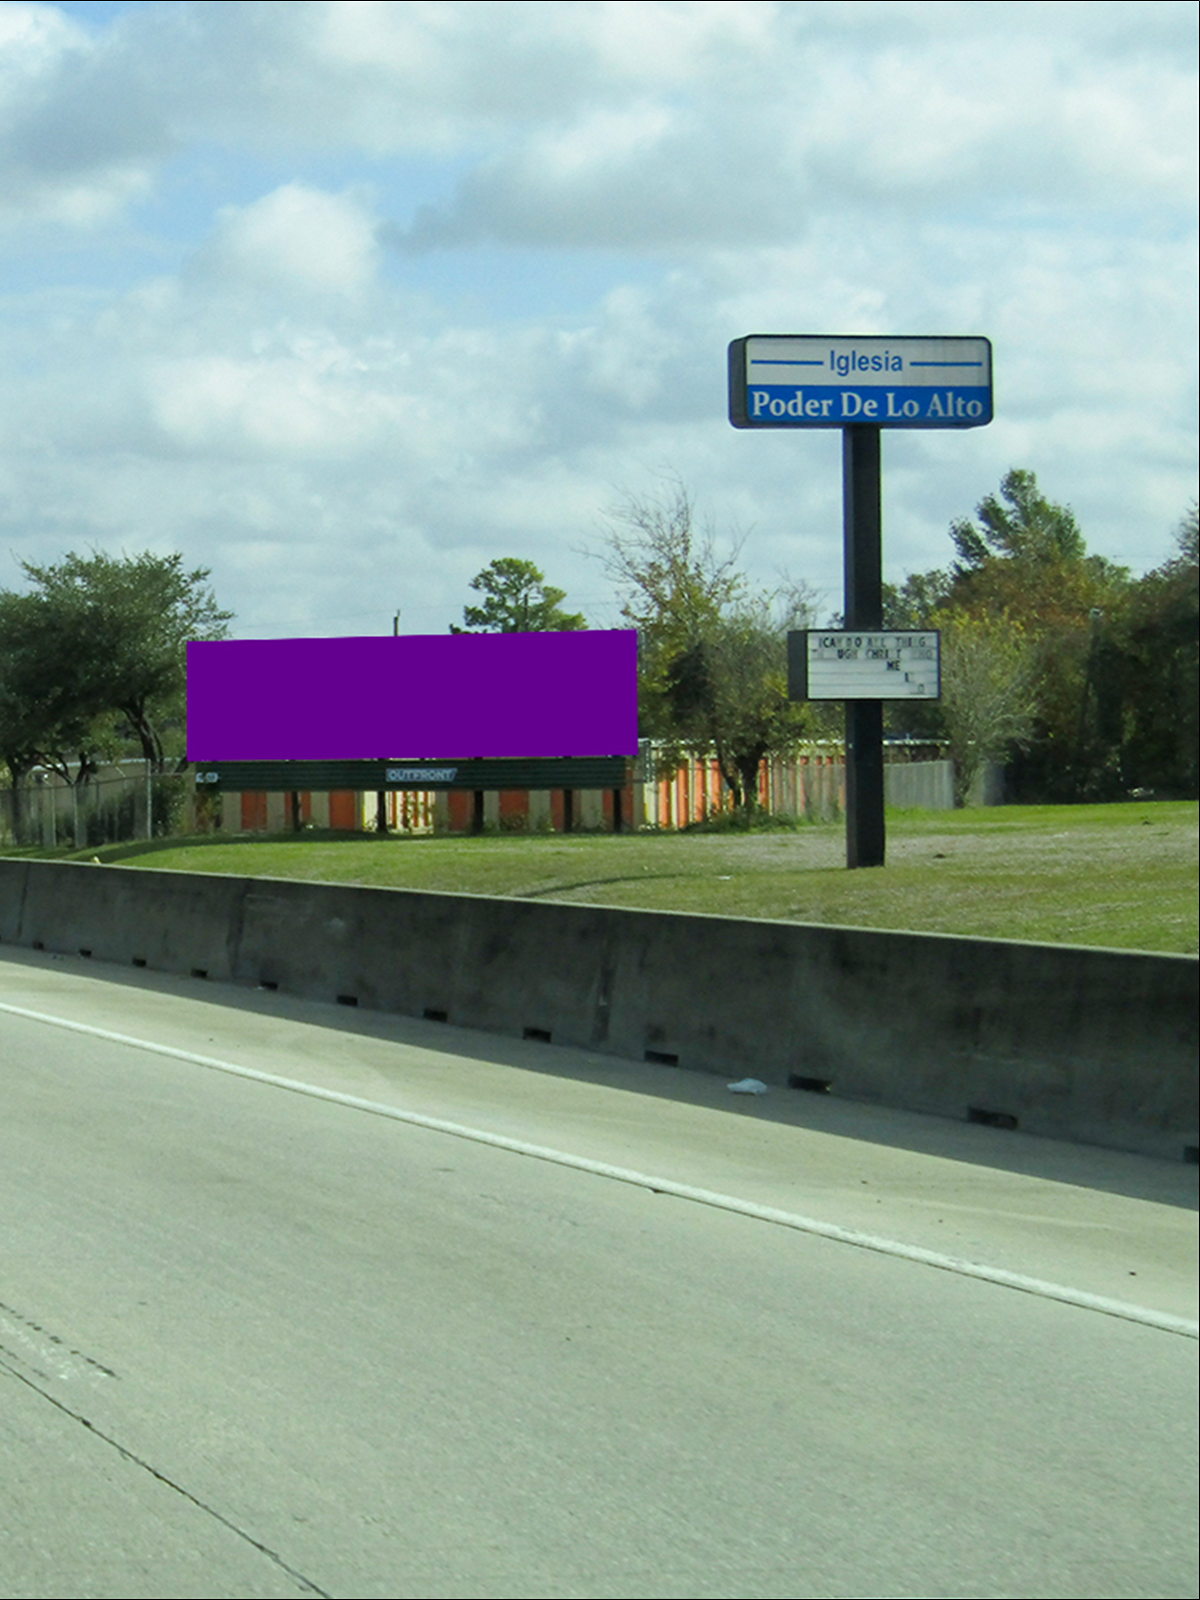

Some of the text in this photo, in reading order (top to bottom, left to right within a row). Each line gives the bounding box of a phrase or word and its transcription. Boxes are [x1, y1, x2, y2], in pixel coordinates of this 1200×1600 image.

[830, 350, 903, 377] Iglesia
[753, 391, 983, 418] Poder De Lo Alto
[388, 769, 453, 781] OUTFRONT
